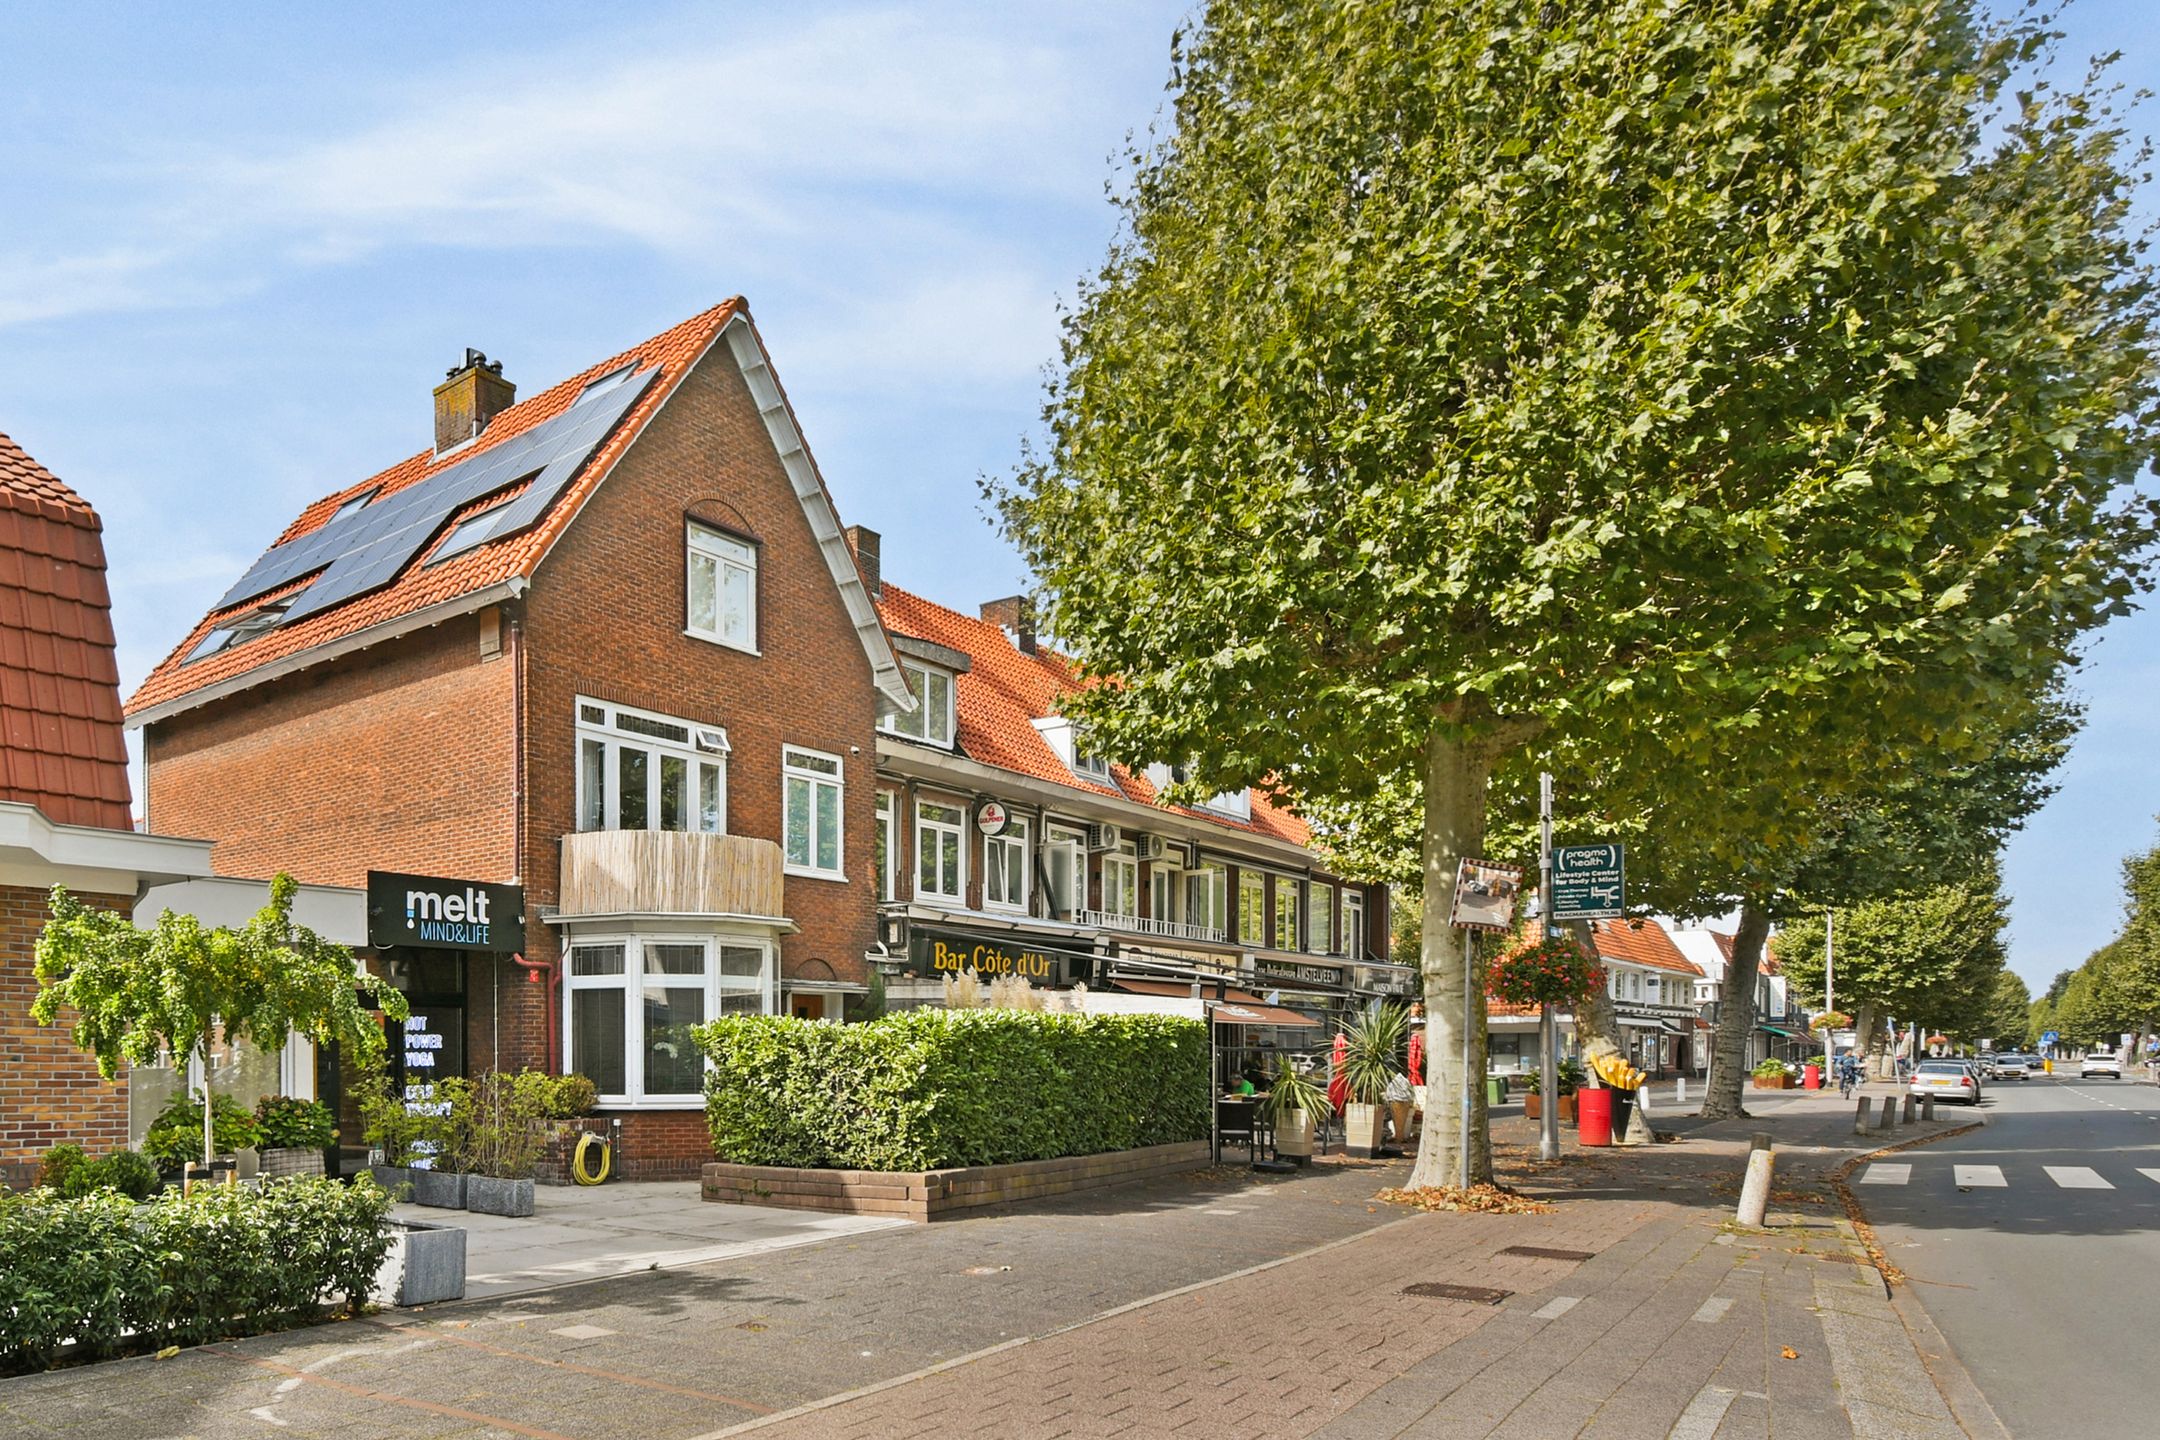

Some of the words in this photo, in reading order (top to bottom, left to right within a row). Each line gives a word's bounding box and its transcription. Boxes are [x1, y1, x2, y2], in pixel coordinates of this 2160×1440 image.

[1566, 849, 1607, 860] pragma
[1570, 857, 1604, 867] health
[407, 887, 490, 926] melt
[420, 921, 490, 945] MIND&LIFE
[934, 942, 967, 970] Bar
[973, 944, 1012, 974] Côte
[405, 1034, 443, 1049] POWER
[405, 1051, 435, 1067] YOGA
